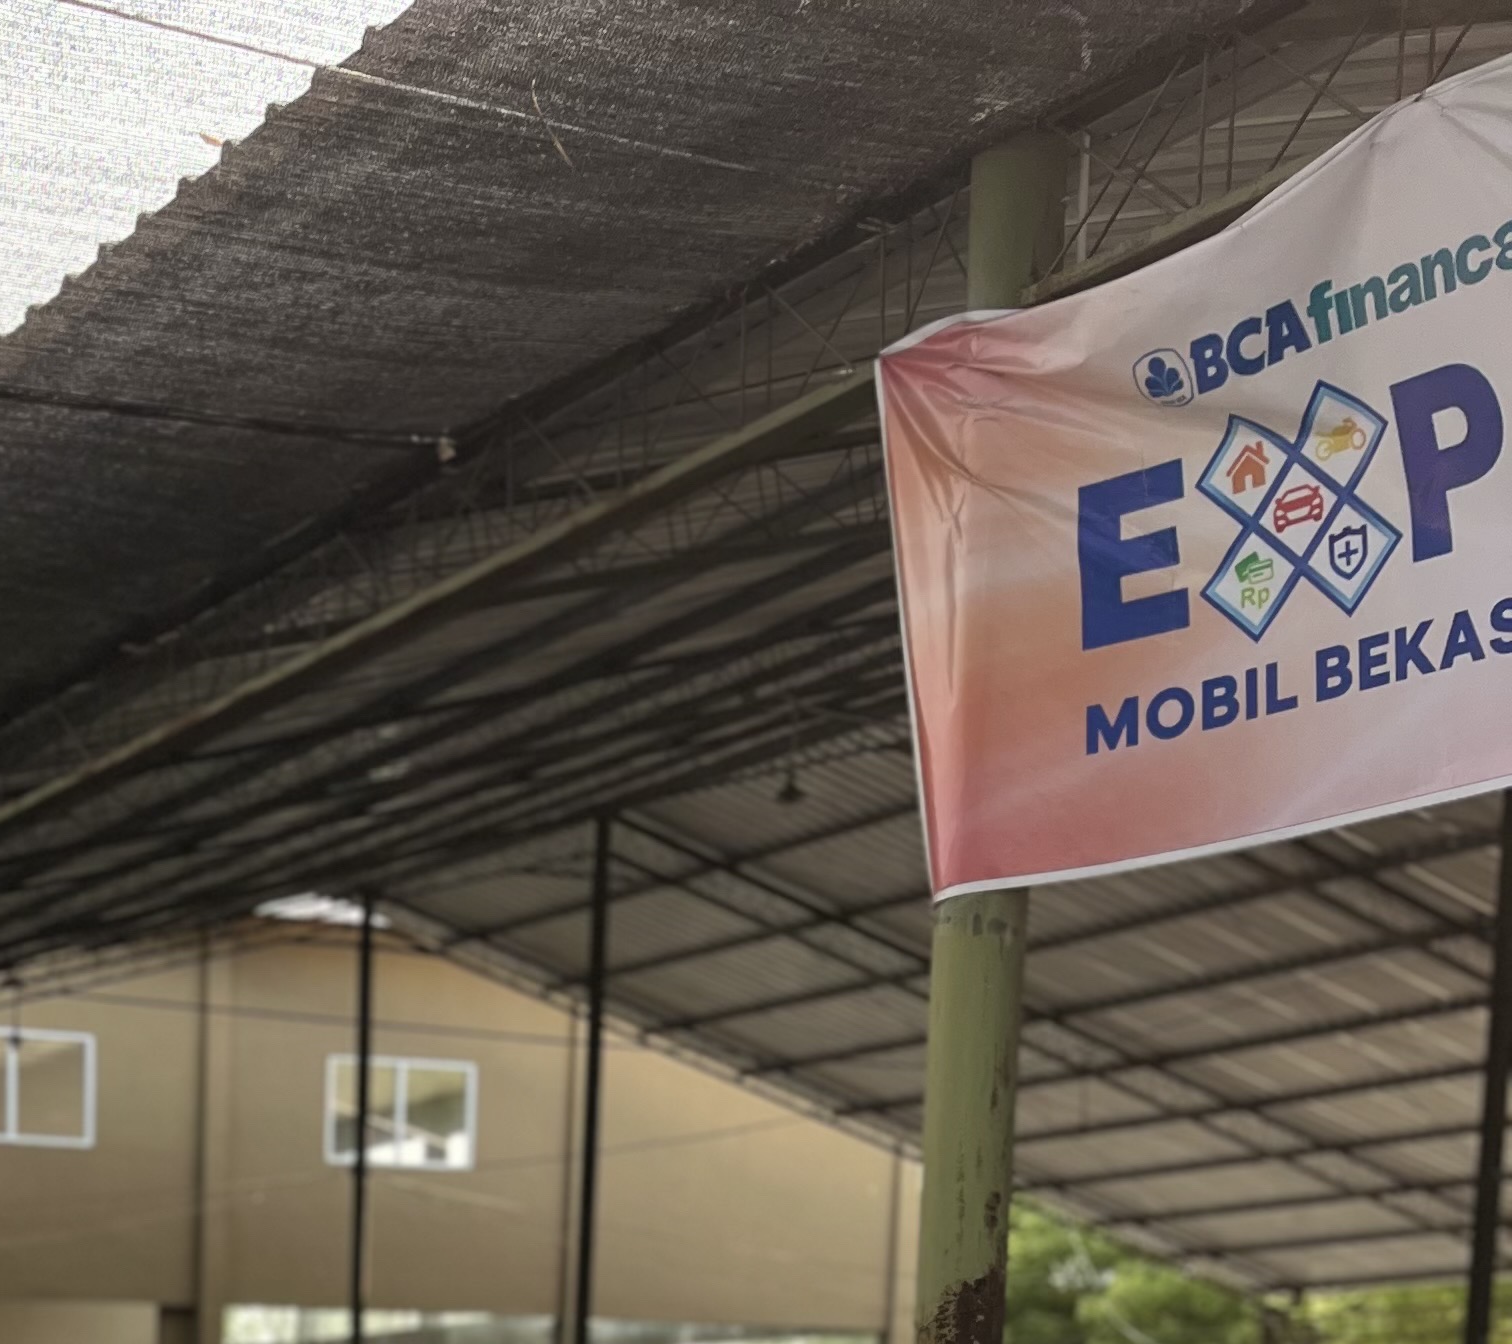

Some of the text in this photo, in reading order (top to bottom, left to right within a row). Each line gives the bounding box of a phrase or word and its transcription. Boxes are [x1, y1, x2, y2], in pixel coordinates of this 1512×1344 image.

[1241, 587, 1270, 609] Rp
[1086, 597, 1512, 755] MOBIL BEKAS
